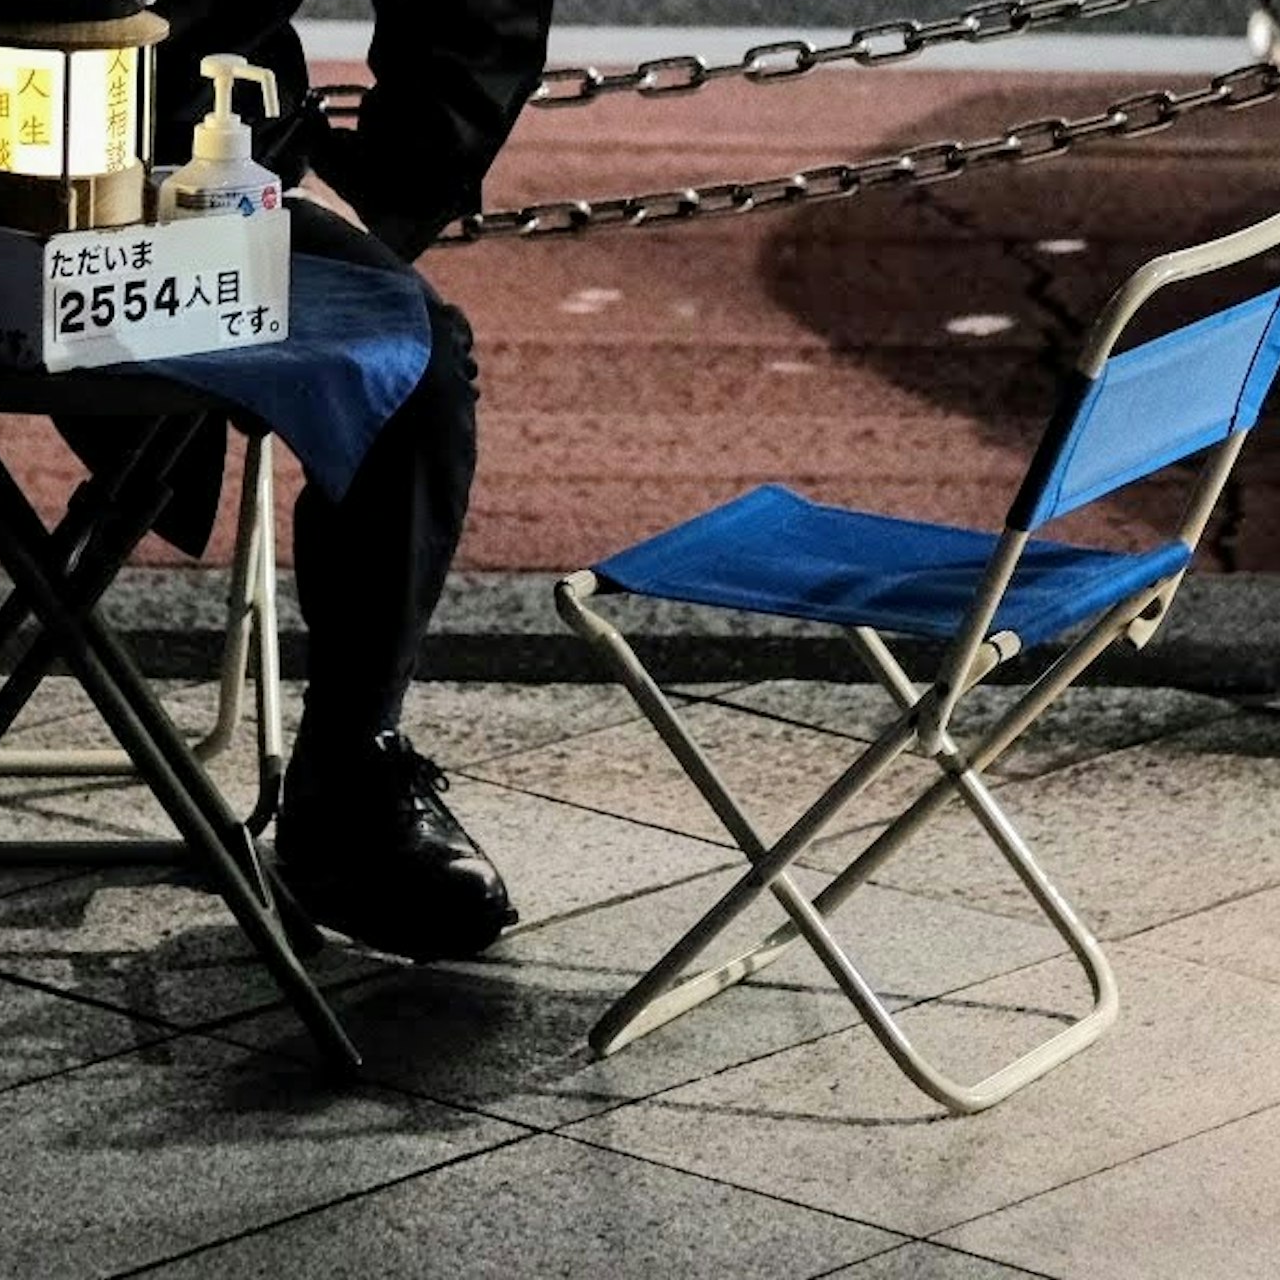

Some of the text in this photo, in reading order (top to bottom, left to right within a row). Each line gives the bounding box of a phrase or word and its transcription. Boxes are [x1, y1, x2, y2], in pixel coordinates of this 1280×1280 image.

[17, 68, 51, 146] 人生
[106, 50, 129, 172] 人生相談
[50, 239, 153, 280] ただいま
[59, 270, 239, 334] 2554人目
[220, 305, 280, 336] です。
